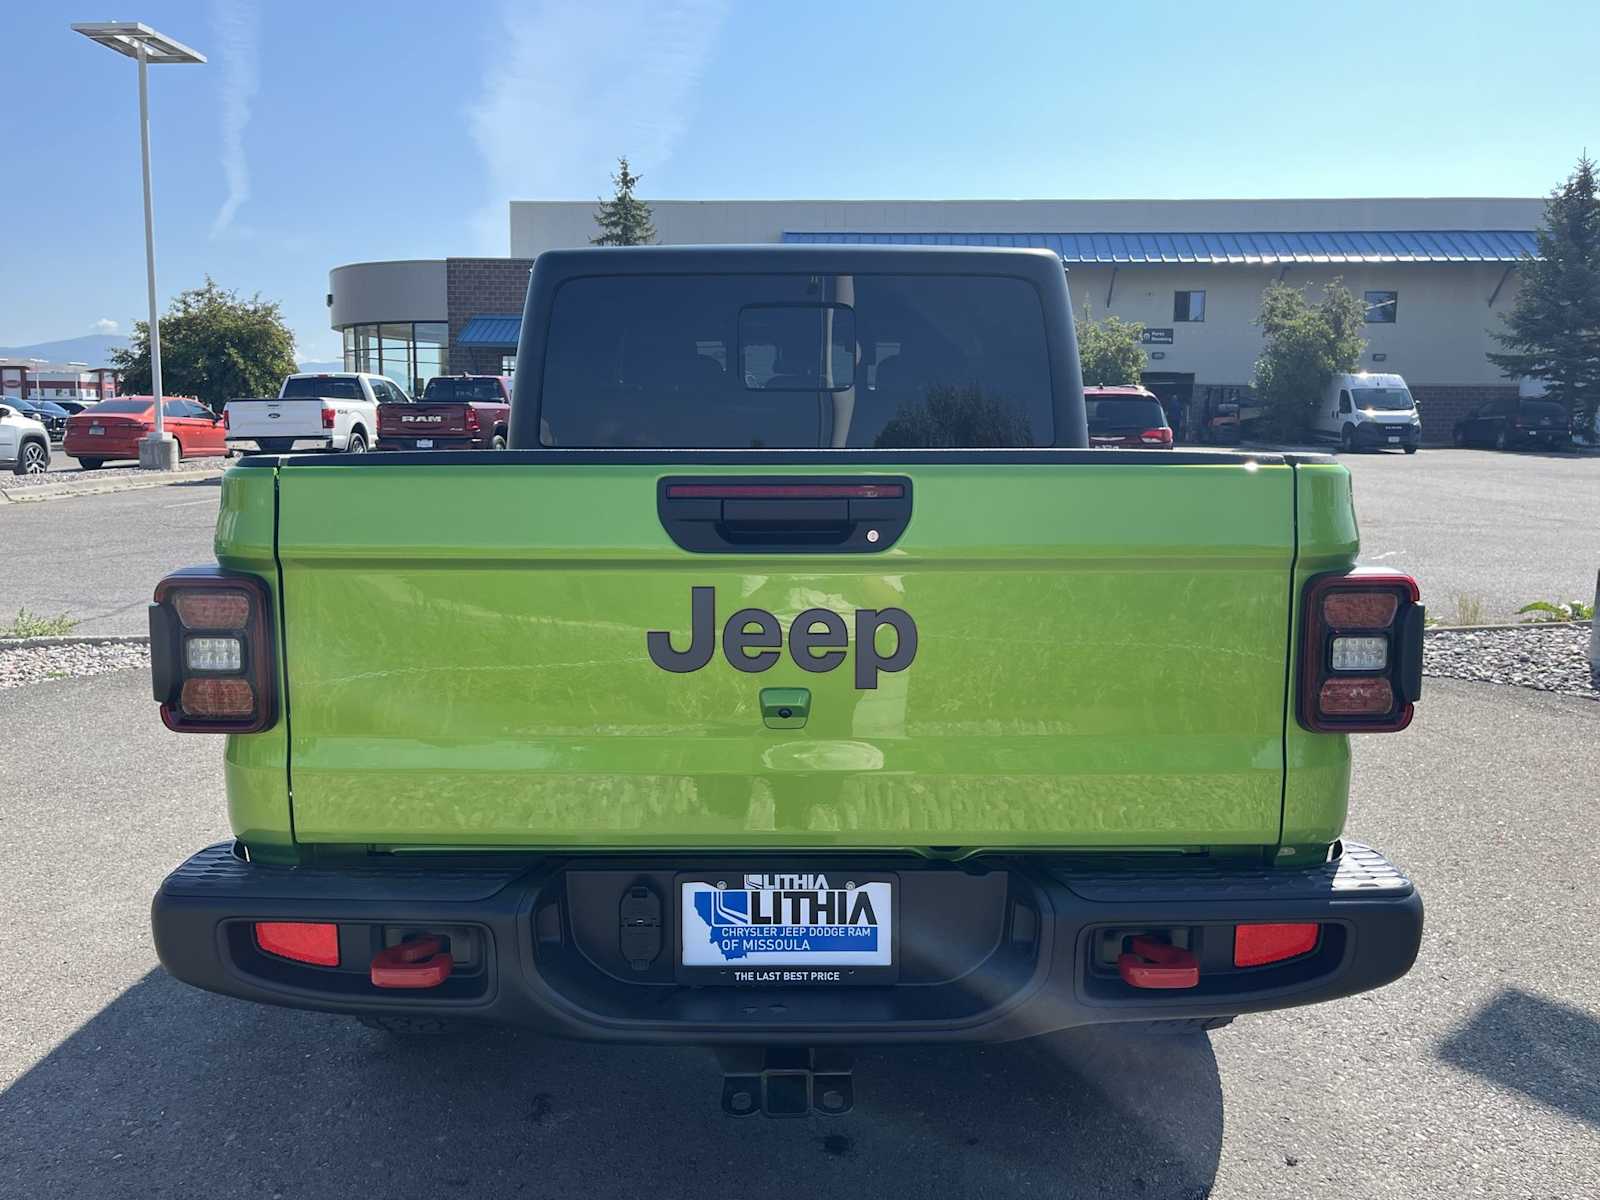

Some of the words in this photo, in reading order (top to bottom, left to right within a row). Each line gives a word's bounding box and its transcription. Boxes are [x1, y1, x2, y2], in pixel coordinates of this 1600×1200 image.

[647, 586, 918, 689] Jeep
[763, 874, 829, 890] LITHIA
[751, 891, 878, 925] LITHIA
[721, 927, 778, 937] CHRYSLER
[780, 927, 806, 937] JEEP
[810, 927, 846, 937] DODGE
[847, 927, 870, 937] RAM
[721, 939, 739, 951] OF
[742, 939, 811, 951] MISSOULA
[734, 972, 754, 981] THE
[756, 972, 781, 981] LAST
[783, 972, 808, 981] BEST
[810, 972, 840, 981] PRICE
